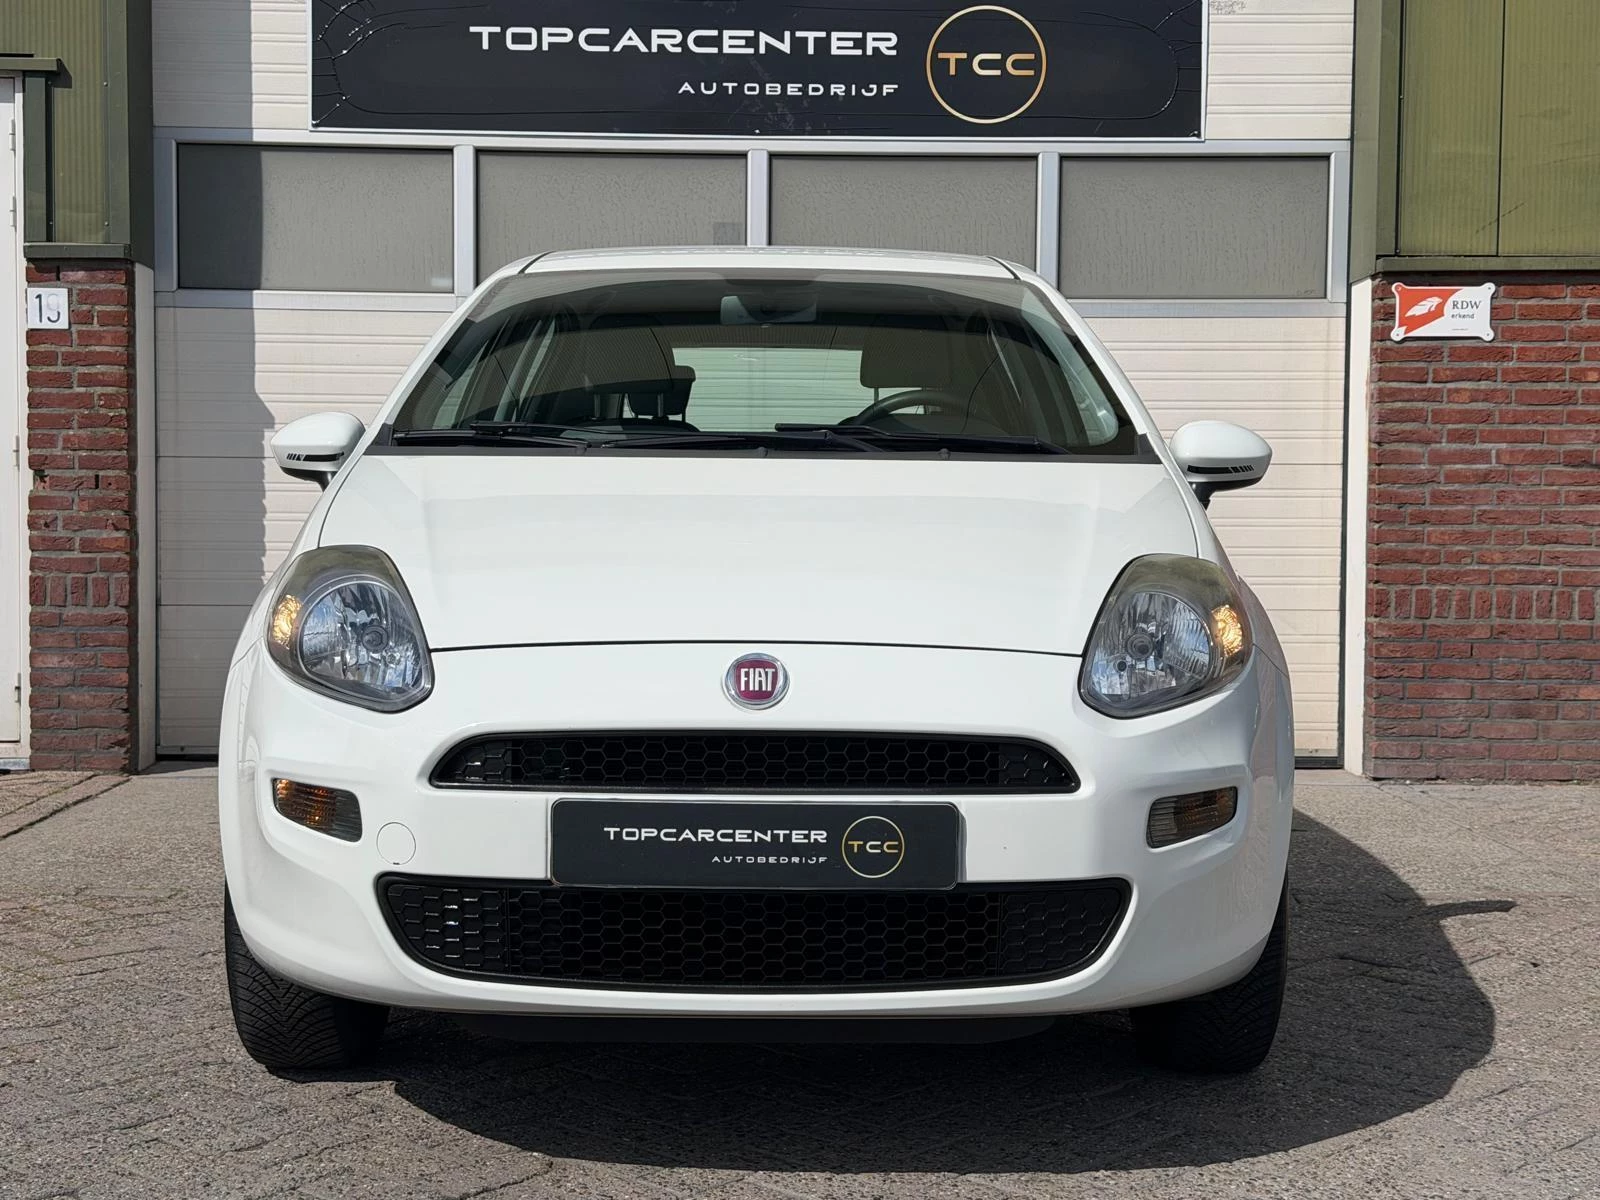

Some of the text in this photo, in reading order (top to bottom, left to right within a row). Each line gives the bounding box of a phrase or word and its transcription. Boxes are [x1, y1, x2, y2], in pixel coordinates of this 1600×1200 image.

[469, 26, 898, 55] TOPCARCENTER
[937, 52, 1035, 76] TCC
[678, 82, 899, 97] AUTOBEDRIJF
[1452, 300, 1482, 310] RDW
[740, 667, 776, 691] FIAT
[603, 827, 828, 843] TOPCARCENTER
[847, 840, 900, 853] TCC
[711, 855, 828, 864] AUTOBEDRIJF
